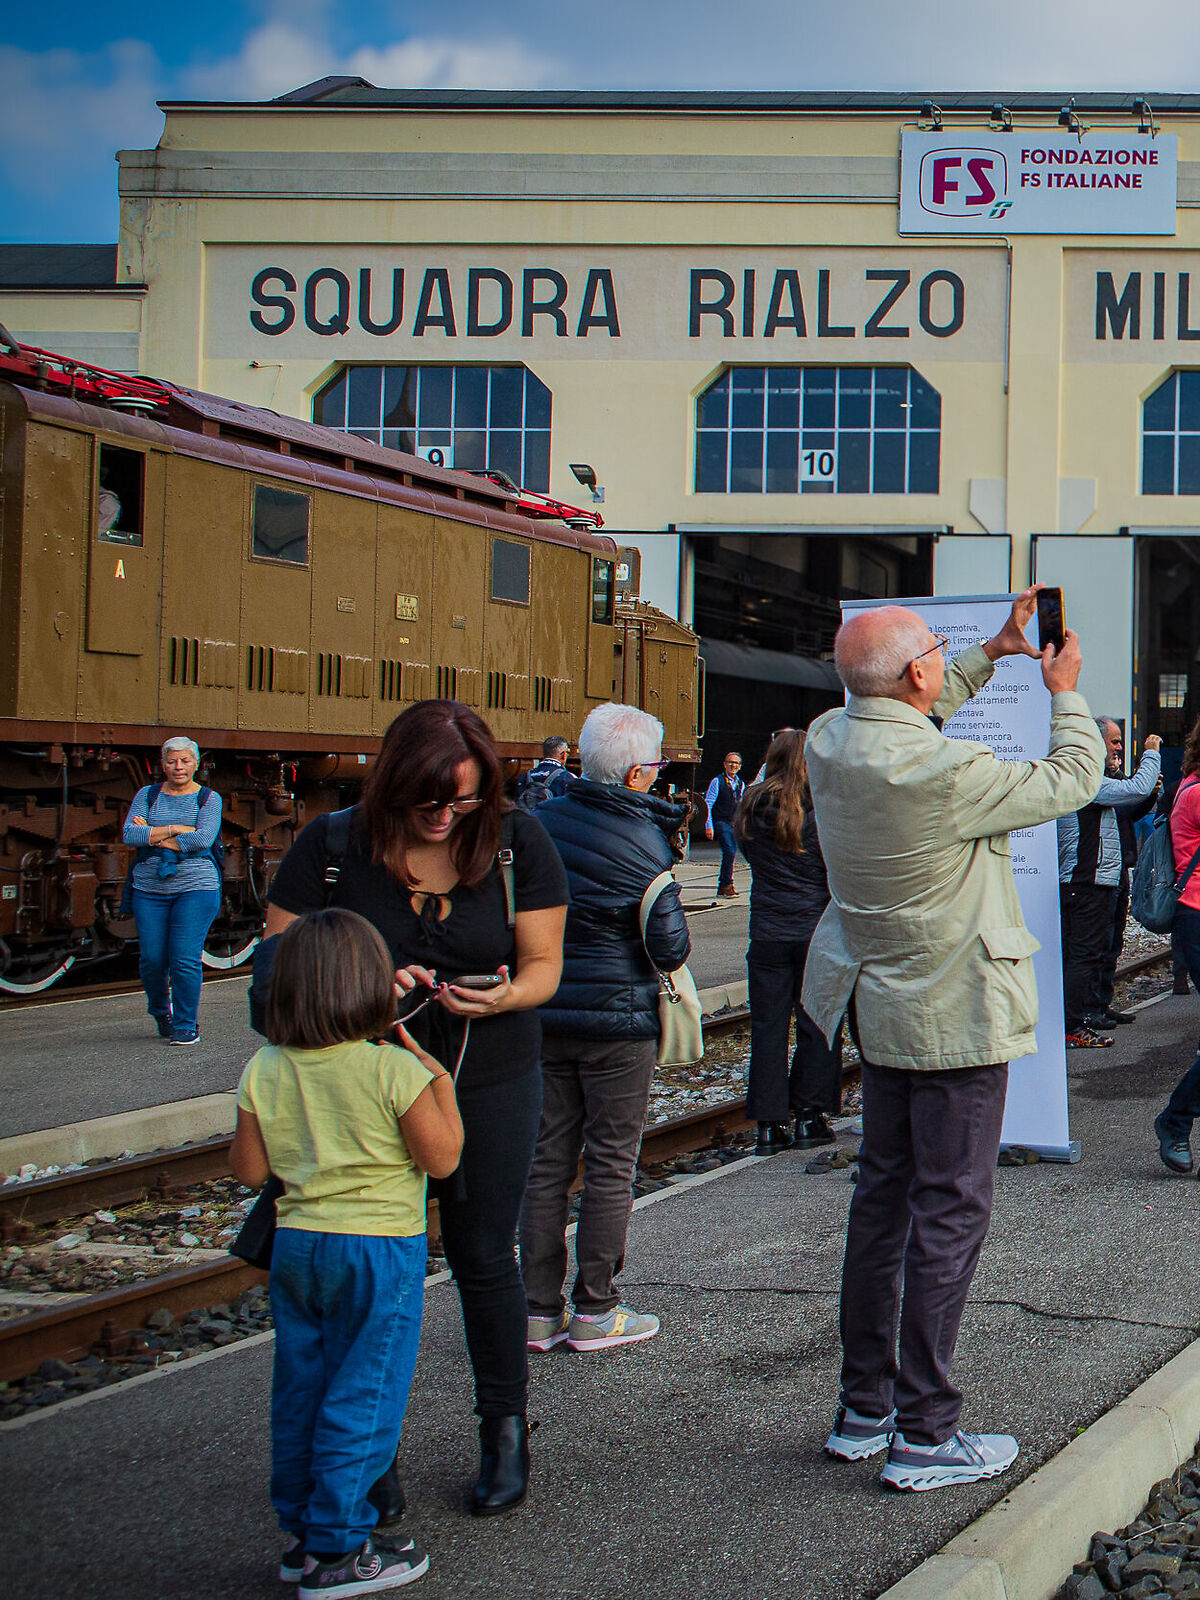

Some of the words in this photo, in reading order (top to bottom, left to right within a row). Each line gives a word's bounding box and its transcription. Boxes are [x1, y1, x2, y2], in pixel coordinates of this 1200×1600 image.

[1020, 148, 1159, 165] FONDAZIONE
[932, 156, 997, 206] FS
[1020, 172, 1041, 188] FS
[1047, 172, 1143, 189] ITALIANE
[249, 266, 621, 338] SQUADRA
[688, 268, 965, 338] RIALZO
[427, 448, 445, 467] 9
[803, 451, 834, 476] 10
[114, 559, 126, 579] A
[992, 682, 1030, 694] filologico
[944, 721, 967, 731] primo
[983, 733, 1012, 741] ancora
